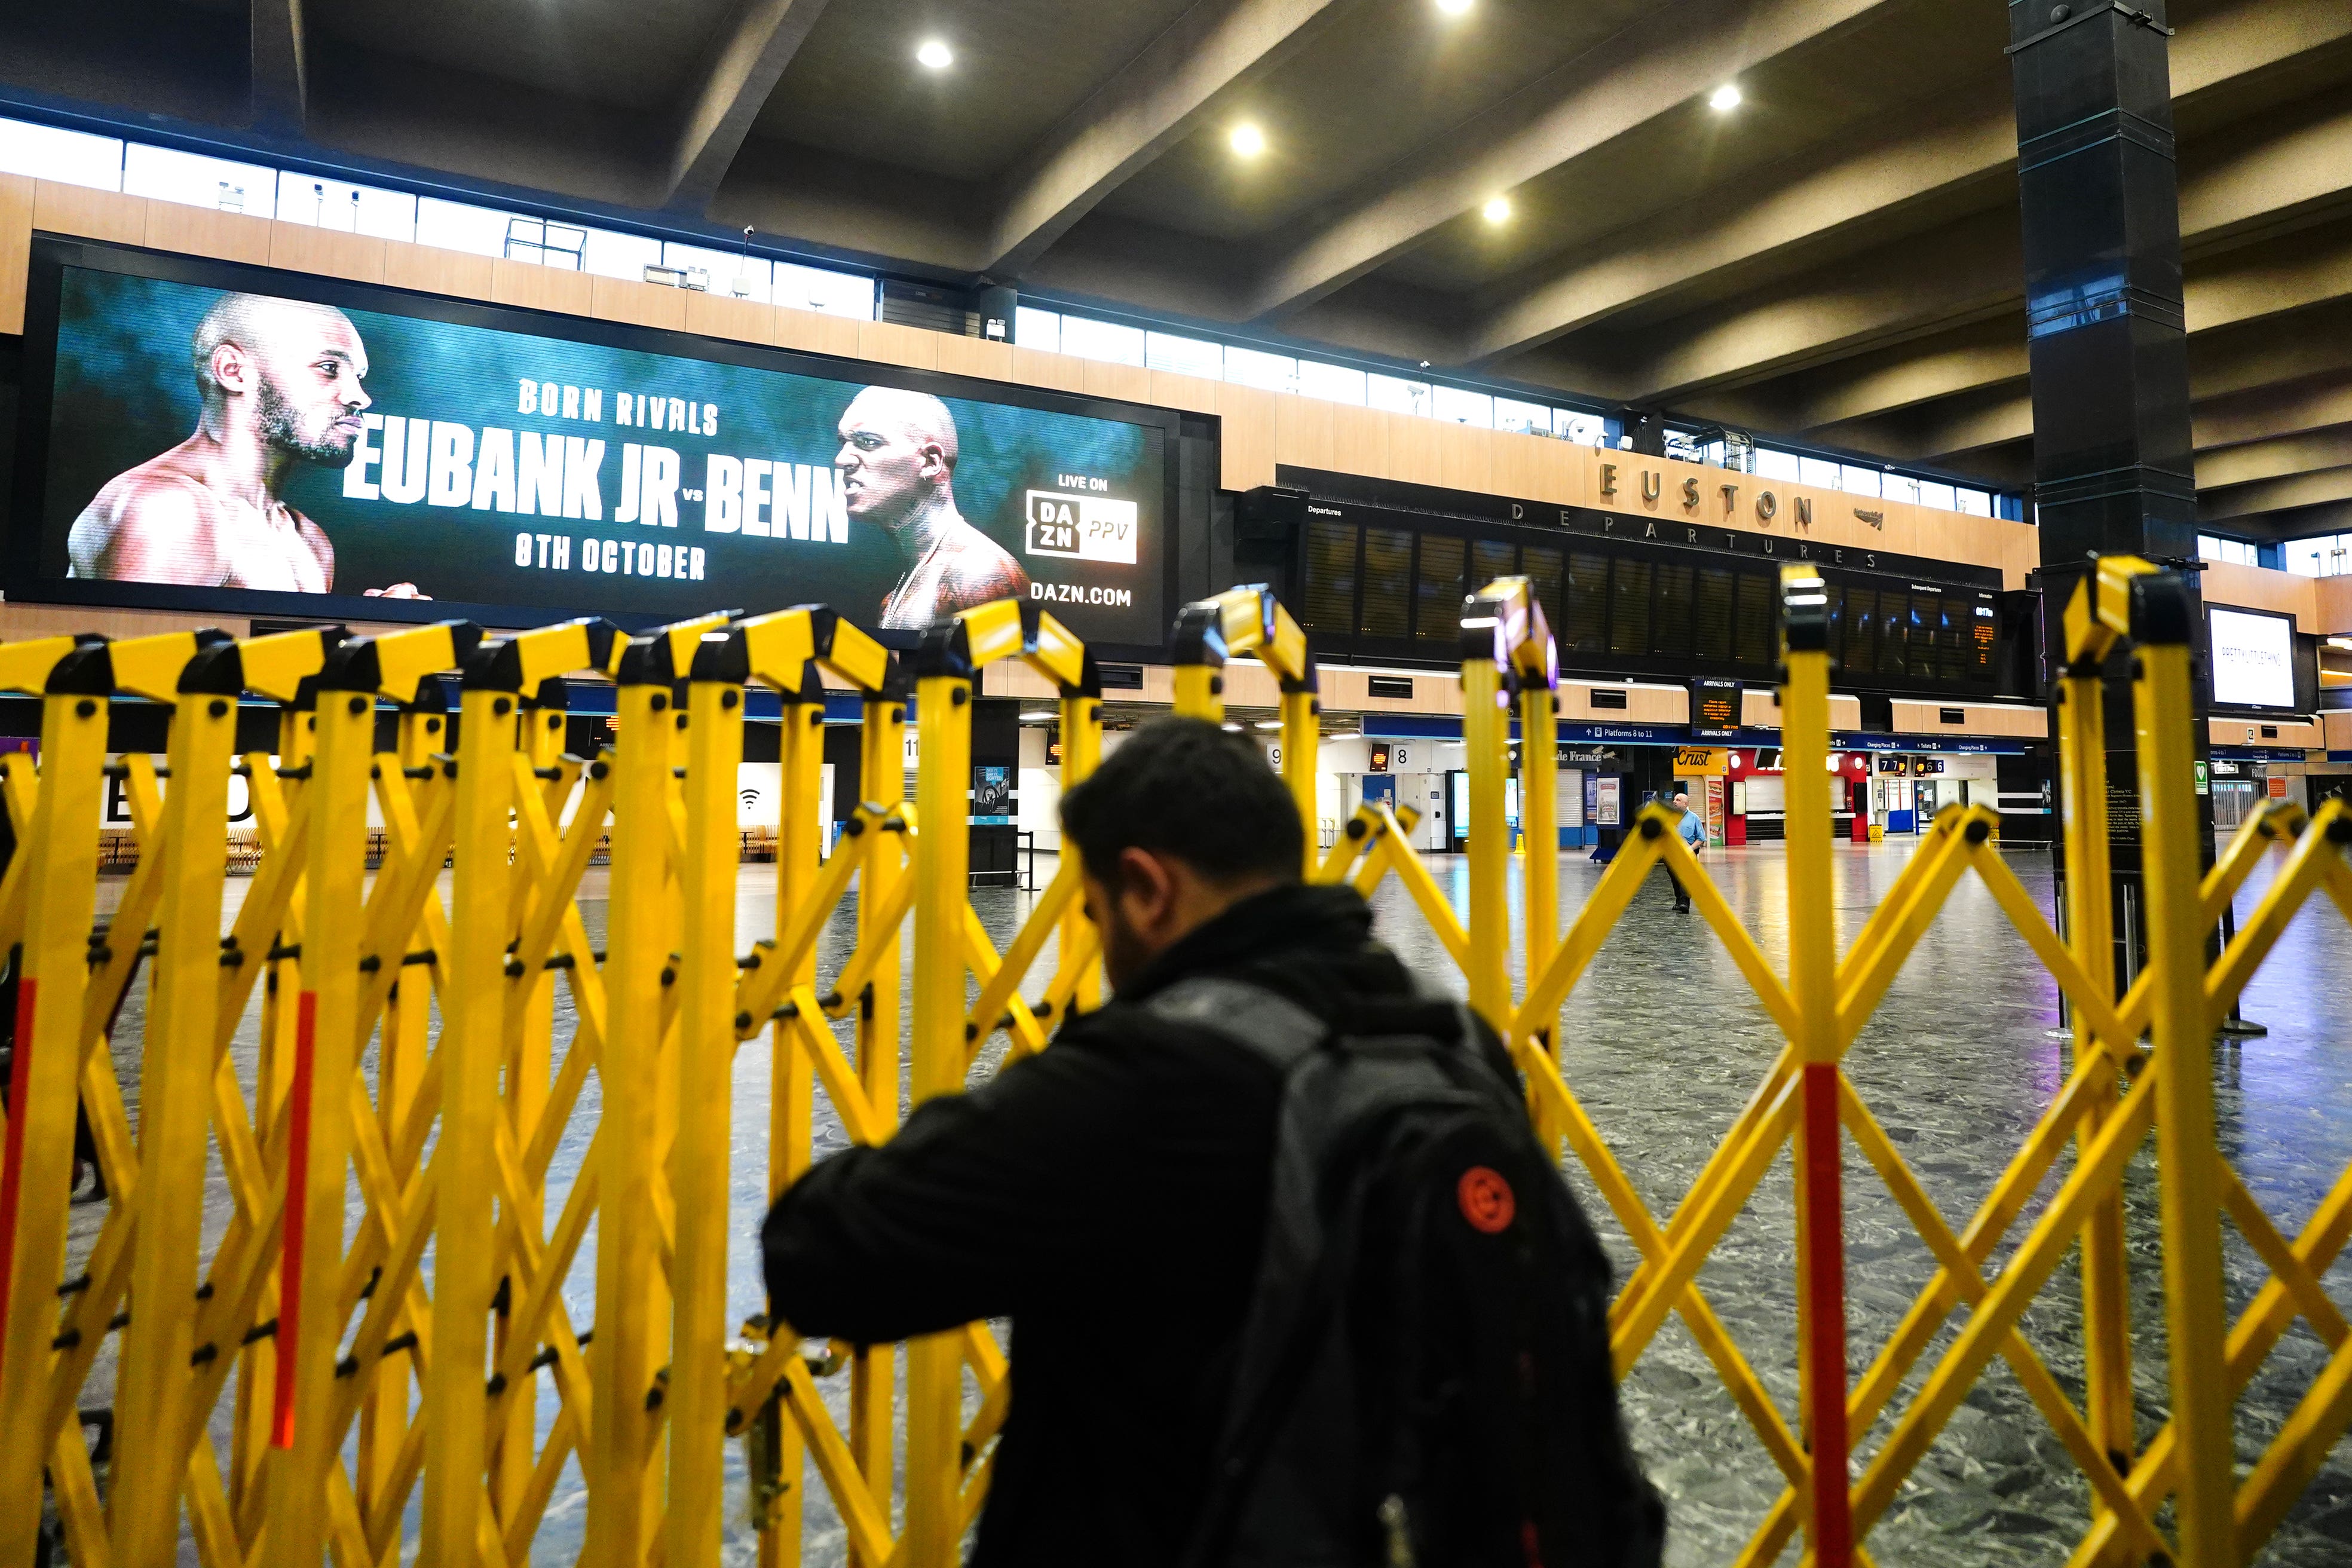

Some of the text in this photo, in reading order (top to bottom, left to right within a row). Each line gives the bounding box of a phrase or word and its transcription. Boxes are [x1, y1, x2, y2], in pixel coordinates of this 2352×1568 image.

[517, 378, 718, 437] BORN RIVALS
[342, 412, 605, 520] EUBANK
[614, 443, 681, 528] JR
[705, 453, 849, 544] BENN
[1058, 473, 1108, 492] LIVE ON
[1600, 463, 1811, 524] EUSTON
[1307, 505, 1342, 517] Departures
[1088, 520, 1128, 541] PPV
[1511, 504, 1875, 568] DEPARTURES
[514, 532, 705, 581] 8TH OCTOBER
[1030, 582, 1131, 607] DAZN.COM
[1604, 729, 1632, 737] Platforms
[1633, 729, 1637, 737] 8
[905, 739, 918, 756] 11
[1557, 751, 1601, 761] de France
[1272, 749, 1281, 764] 9
[1398, 749, 1407, 764] 8
[1677, 749, 1712, 766] Crust
[1893, 760, 1898, 769] 7
[1882, 761, 1888, 770] 7
[1927, 762, 1933, 771] 6
[1937, 761, 1942, 771] 6
